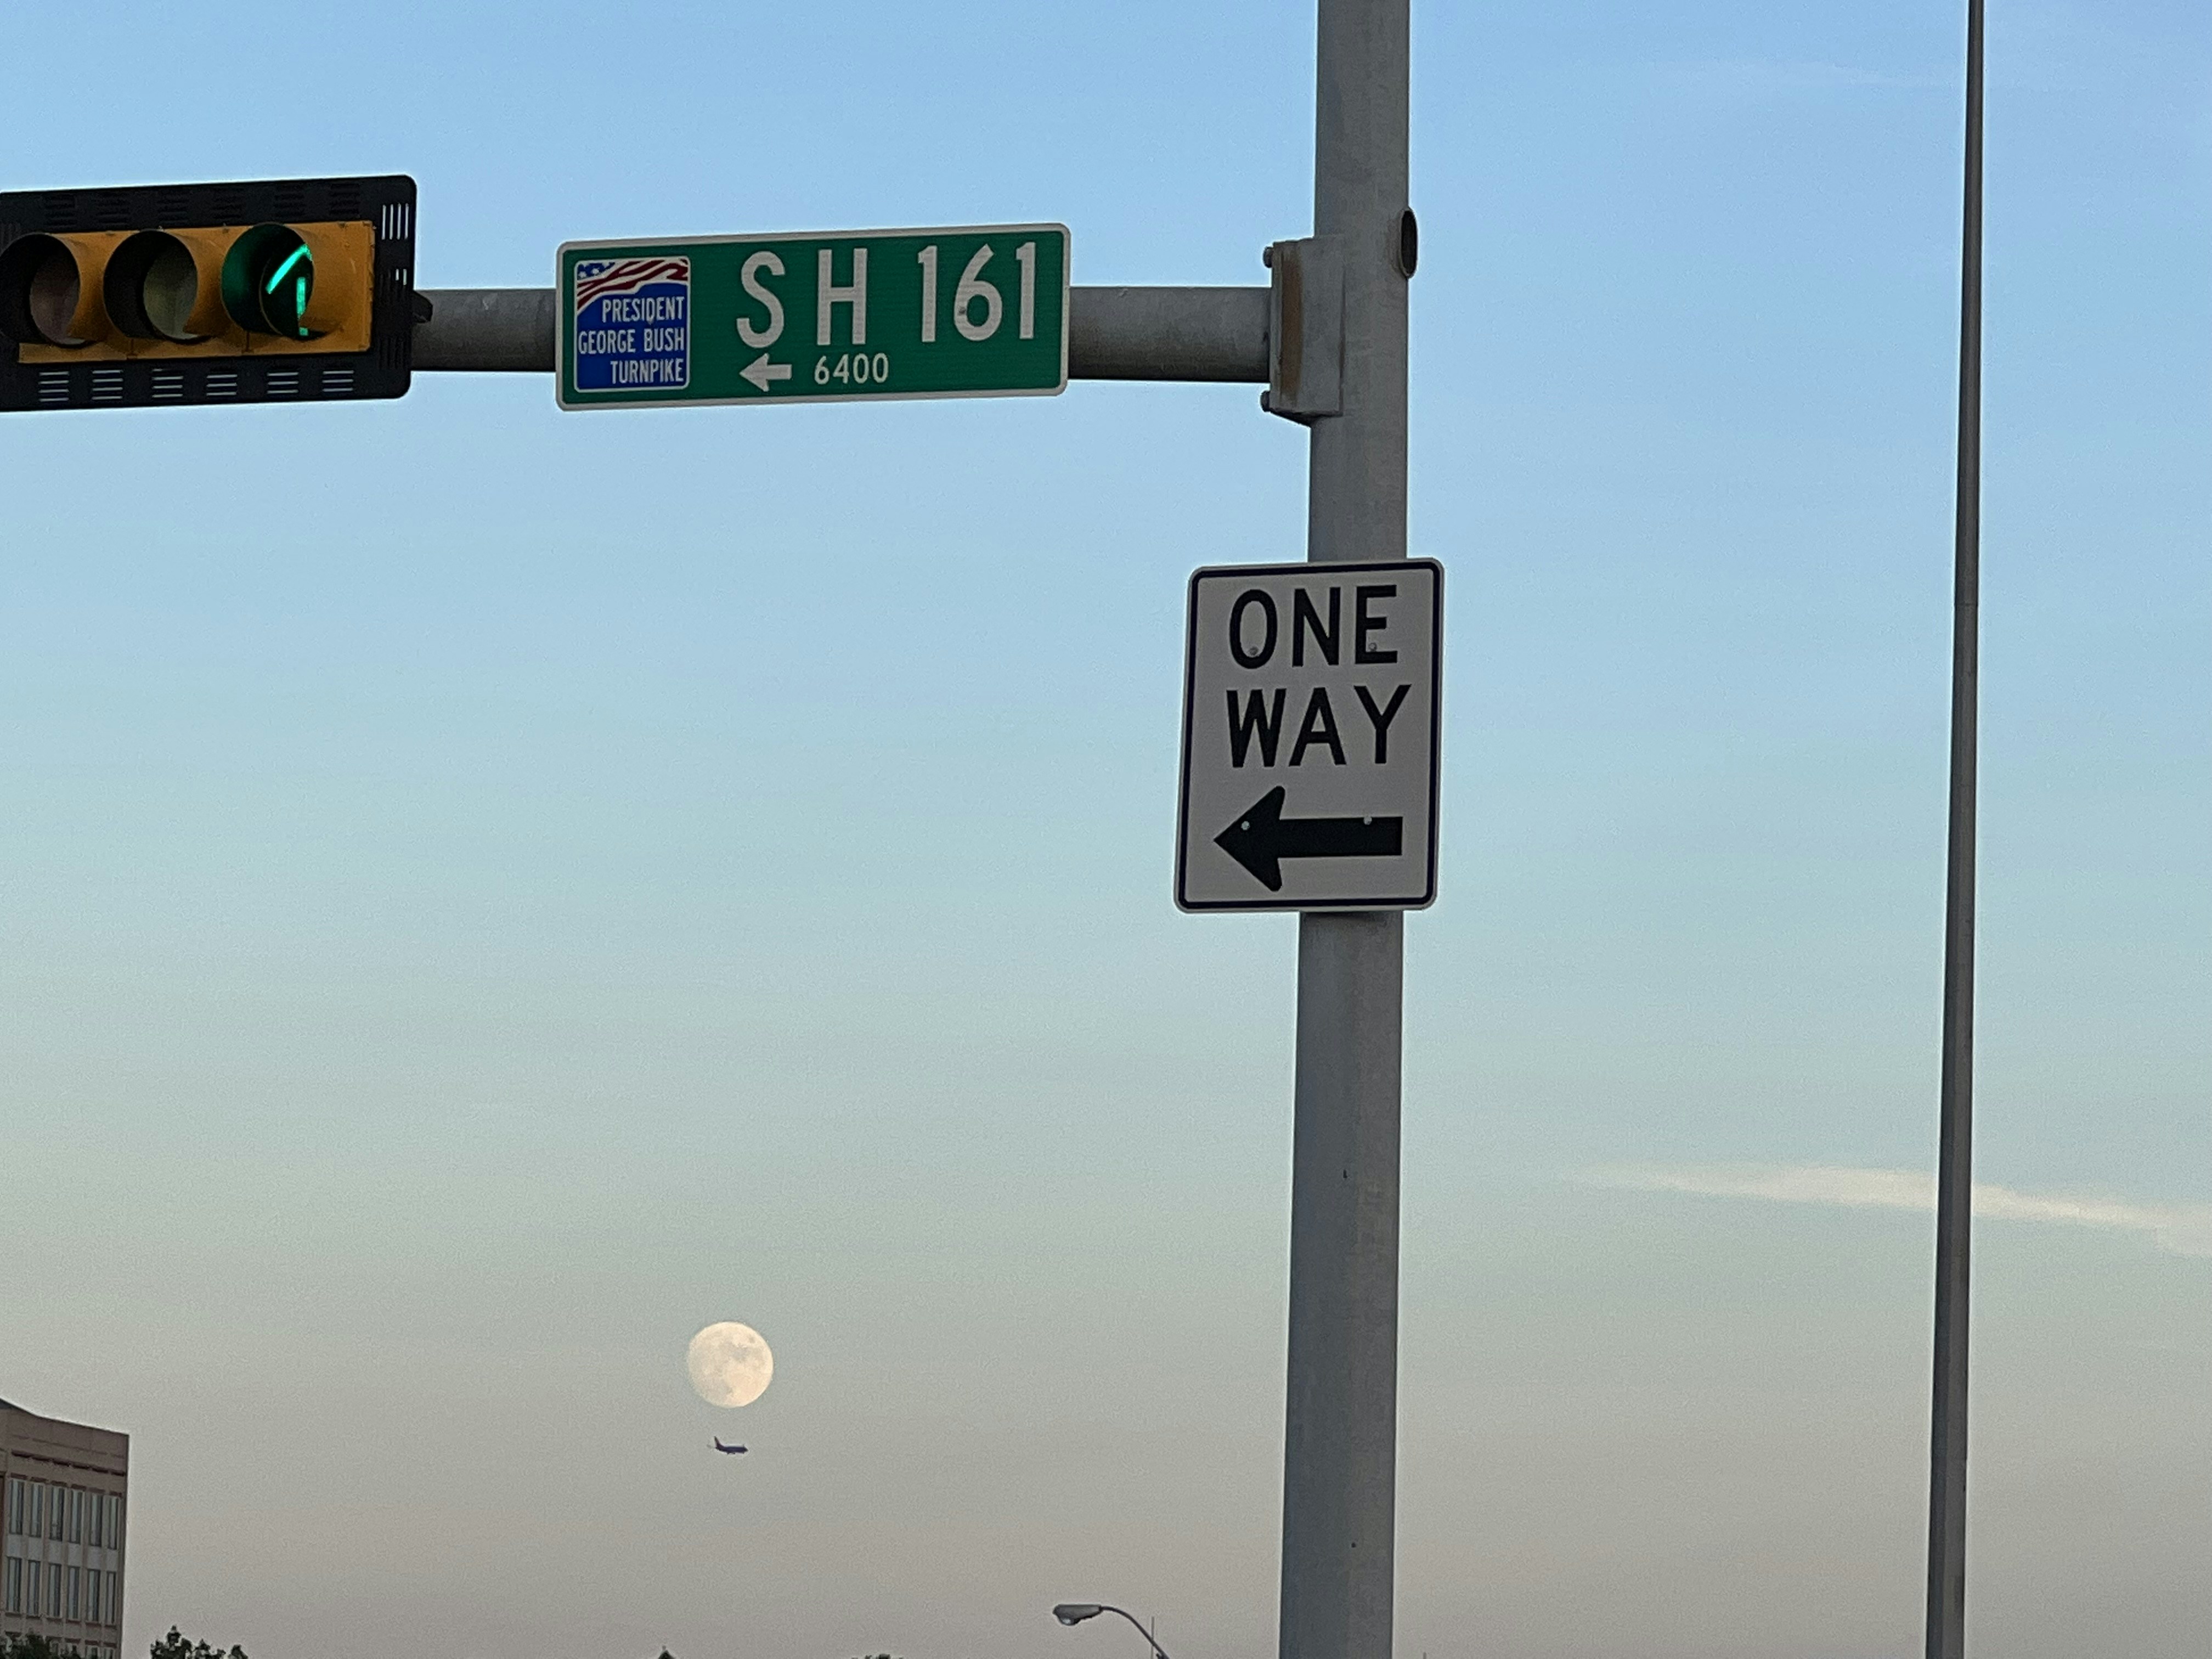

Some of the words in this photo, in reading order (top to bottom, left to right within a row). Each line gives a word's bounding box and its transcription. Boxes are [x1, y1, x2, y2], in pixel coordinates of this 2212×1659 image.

[917, 242, 1036, 343] 161
[602, 296, 685, 323] PRESIDENT
[578, 329, 636, 354] GEORGE
[644, 328, 685, 352] BUSH
[610, 358, 684, 384] TURNPIKE
[814, 353, 889, 384] 6400
[1229, 584, 1398, 669] ONE
[1226, 684, 1412, 768] WAY
